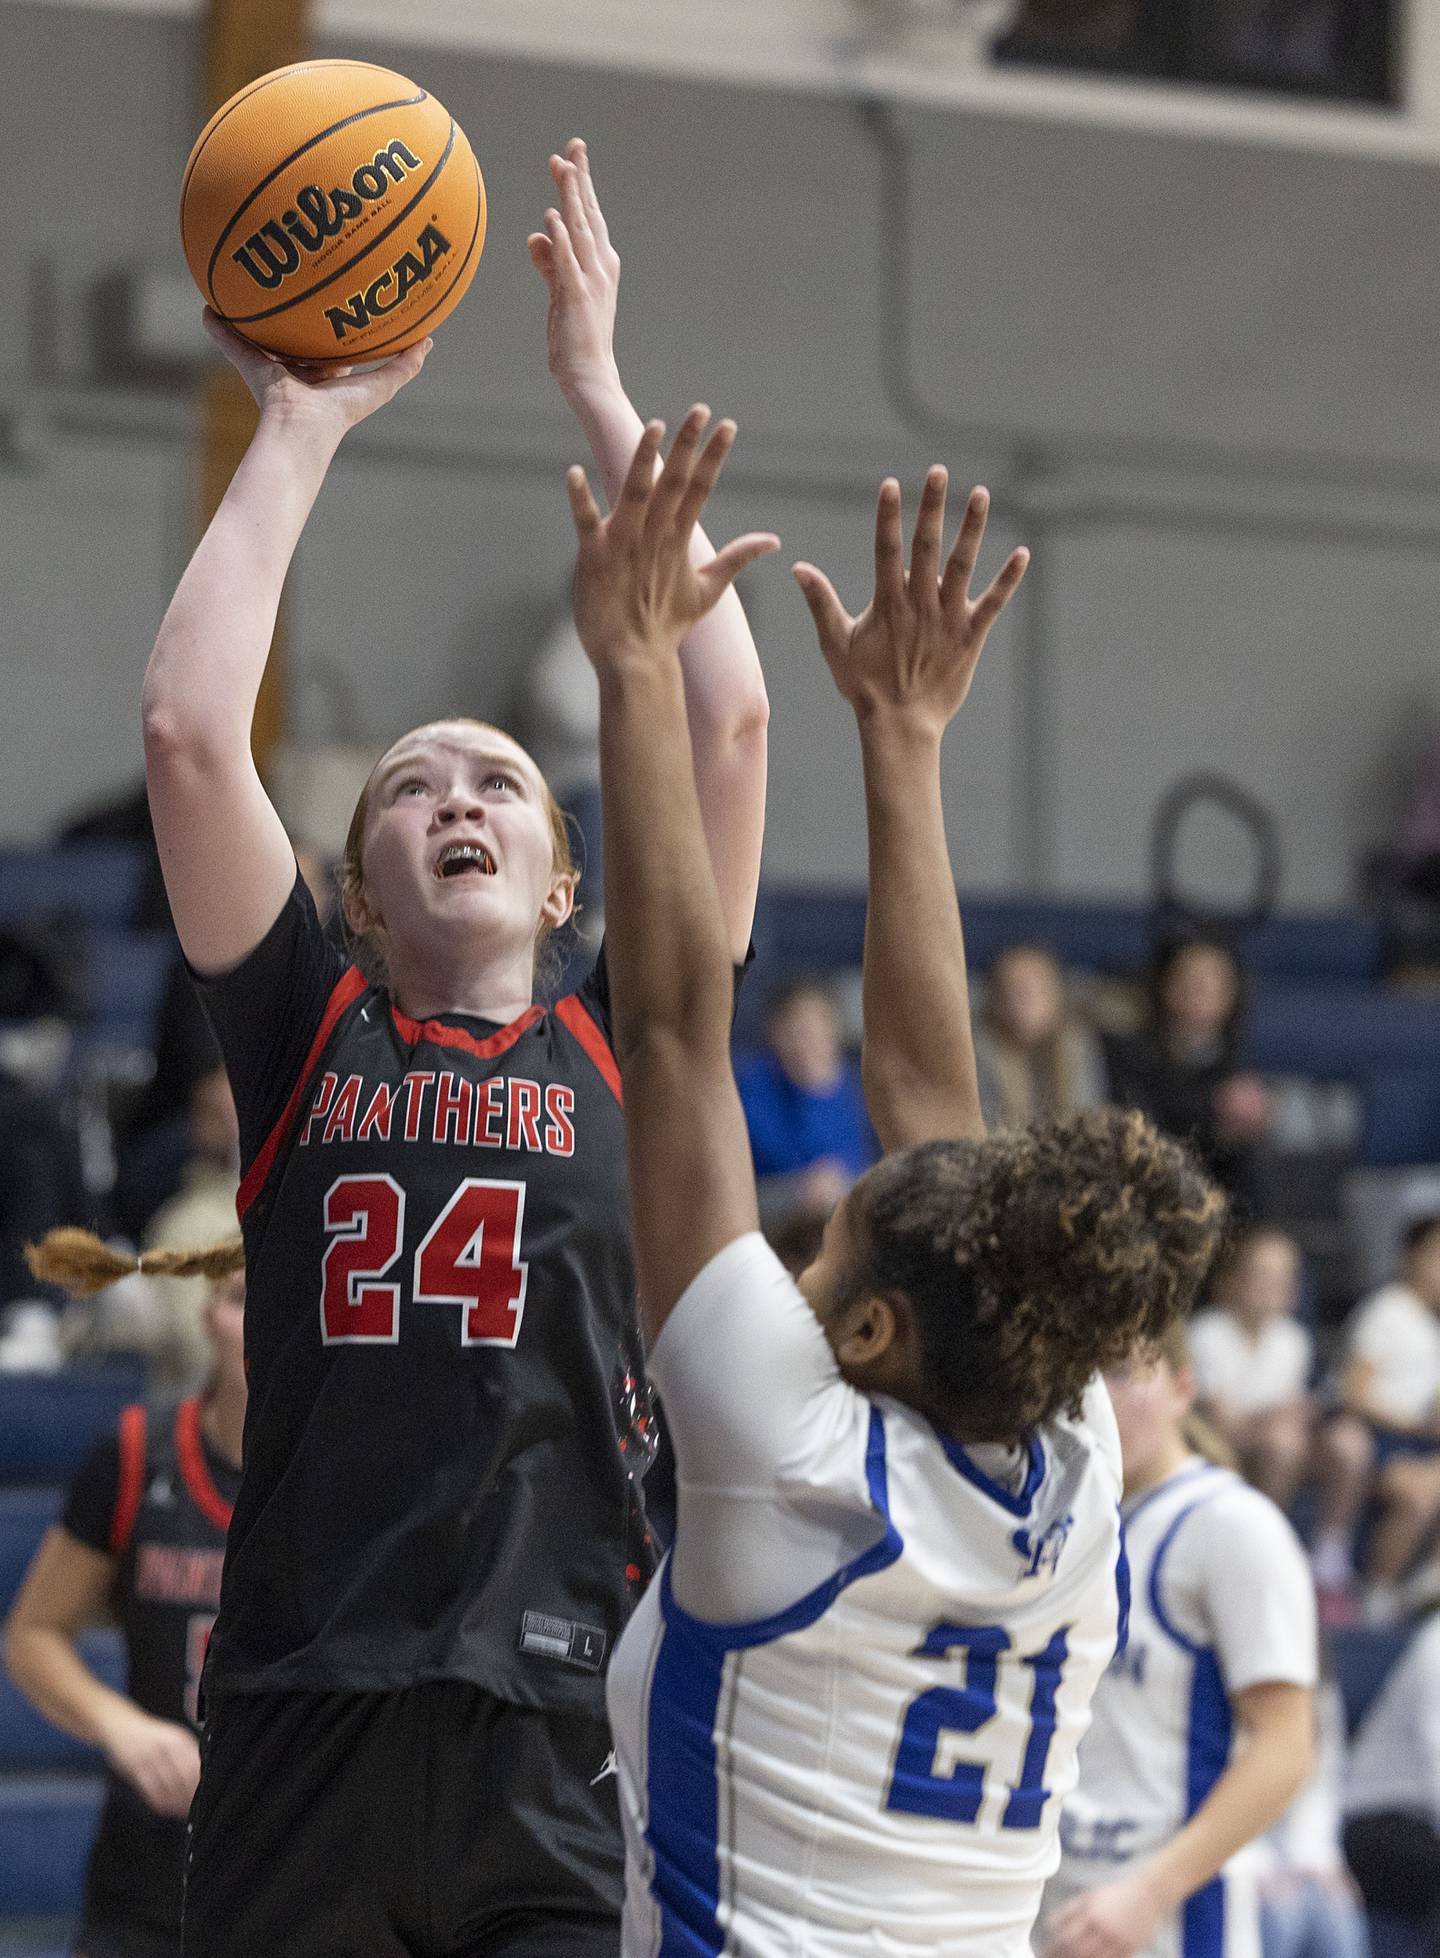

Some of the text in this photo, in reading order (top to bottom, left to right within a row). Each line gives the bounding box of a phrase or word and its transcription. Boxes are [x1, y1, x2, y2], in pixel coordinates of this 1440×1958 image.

[231, 136, 422, 291] Wilson
[322, 222, 452, 341] NCAA
[299, 1070, 576, 1159] PANTHERS
[319, 1171, 529, 1350] 24
[583, 1635, 593, 1657] L
[882, 1618, 1076, 1832] 21
